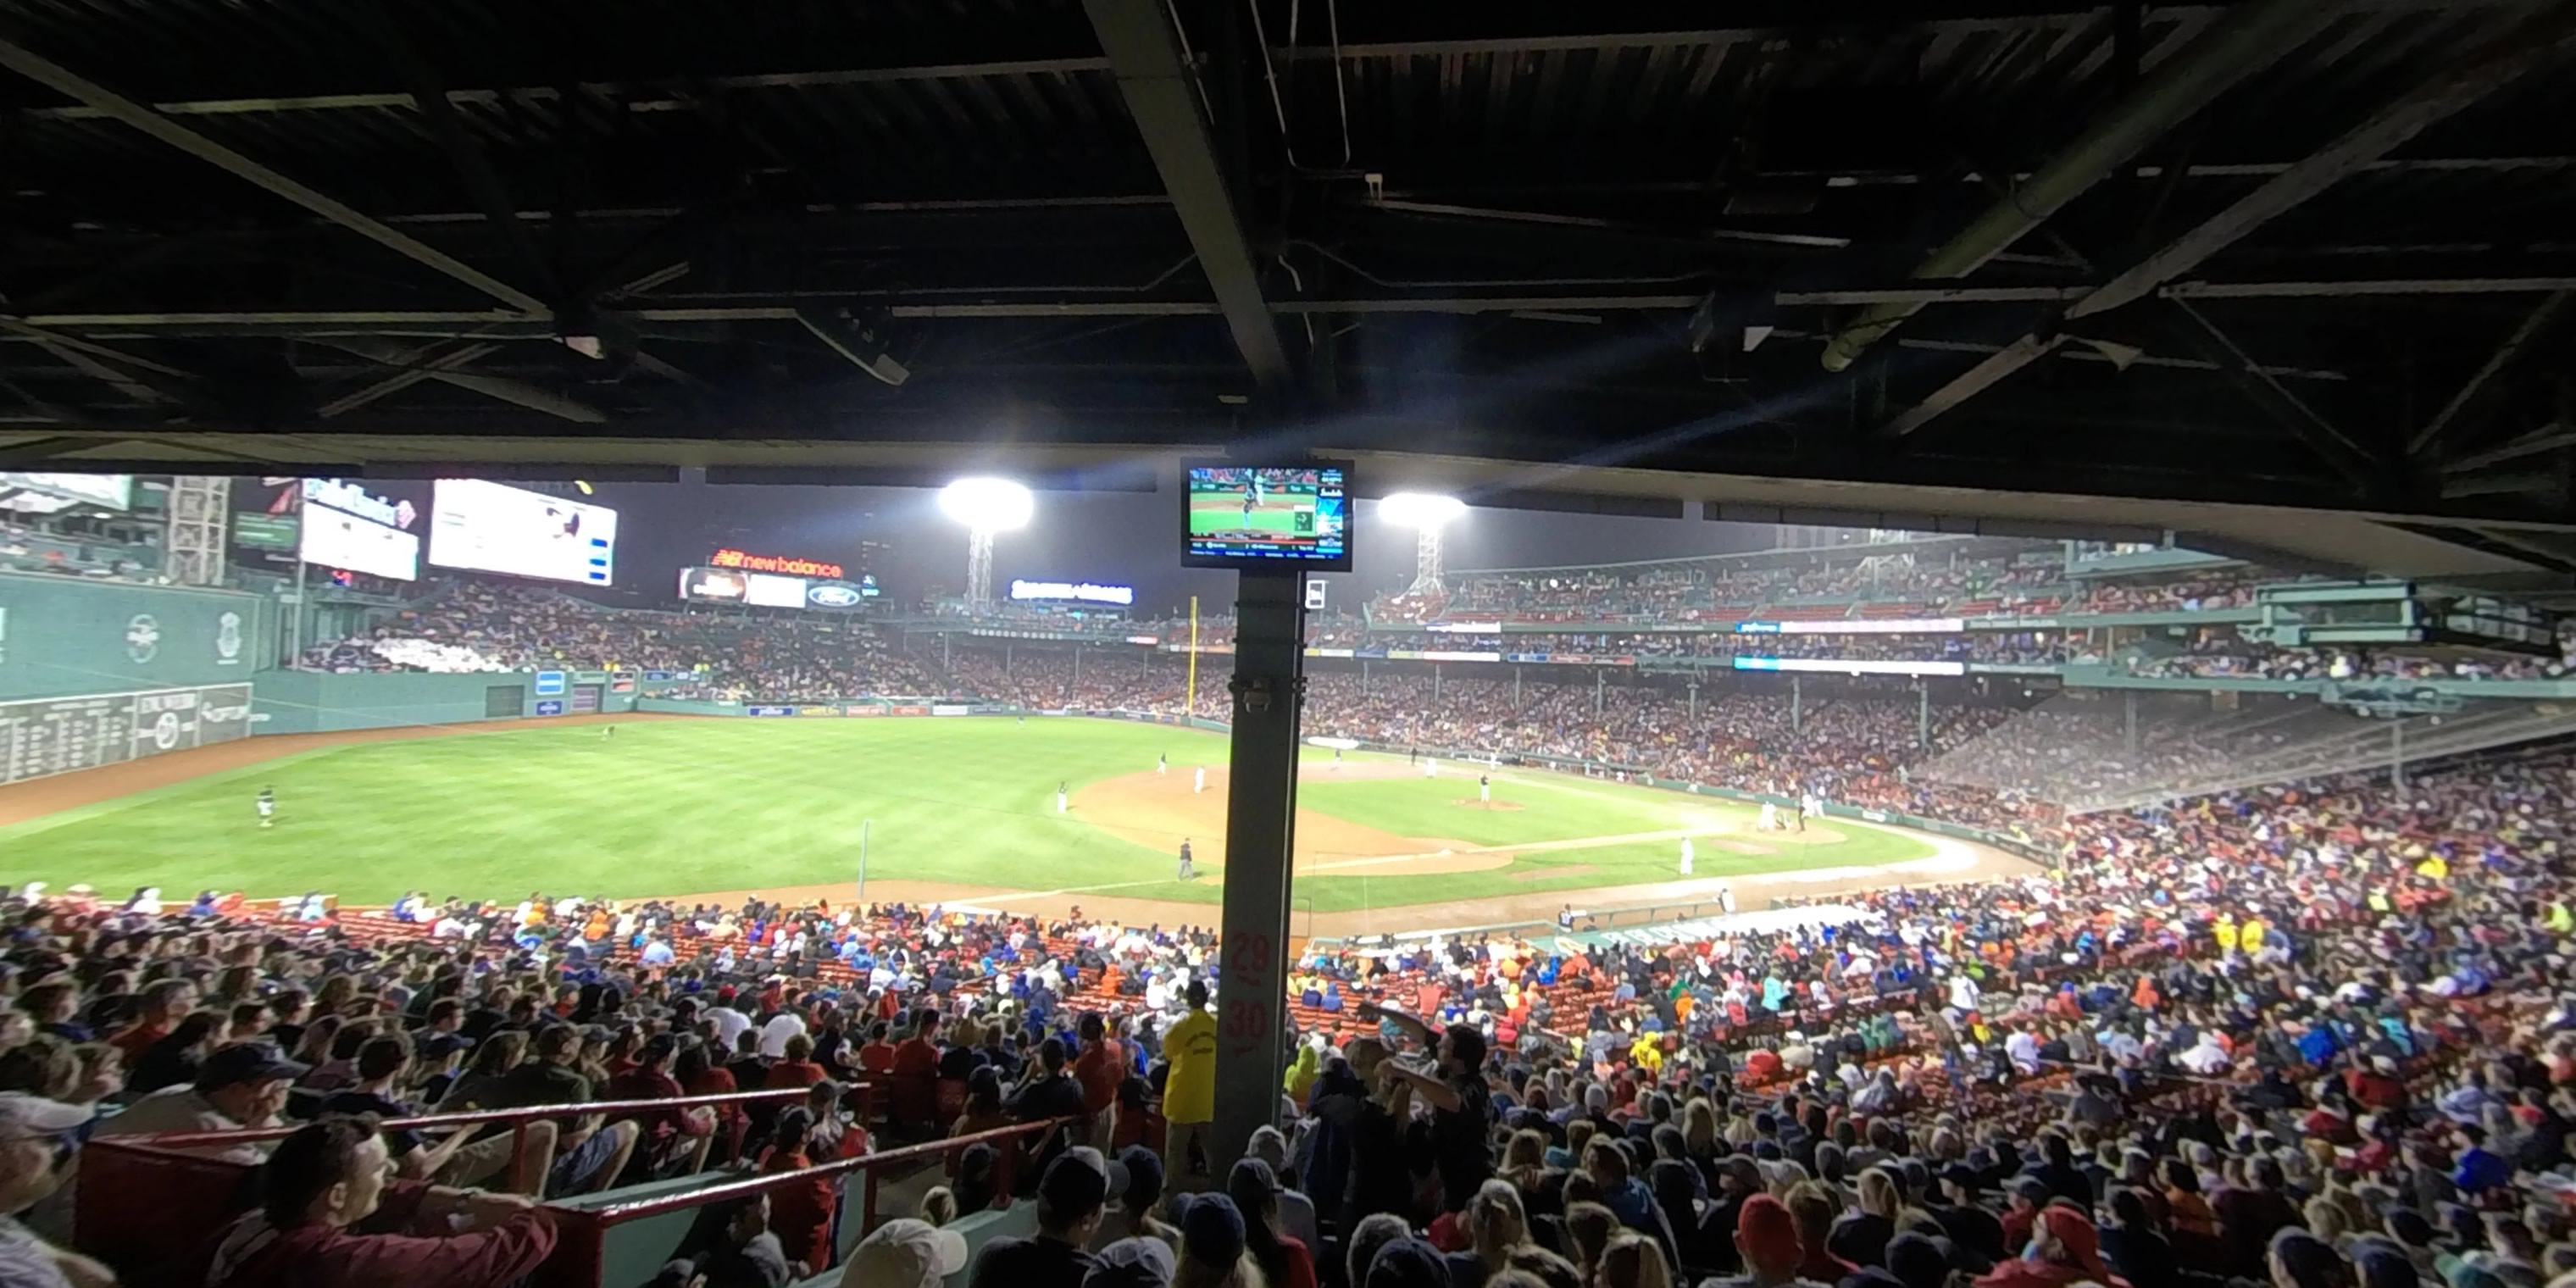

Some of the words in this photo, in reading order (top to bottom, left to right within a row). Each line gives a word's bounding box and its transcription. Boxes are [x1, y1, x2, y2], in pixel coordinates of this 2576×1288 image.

[743, 556, 776, 571] new
[778, 557, 842, 578] balance
[1227, 1000, 1268, 1040] 30
